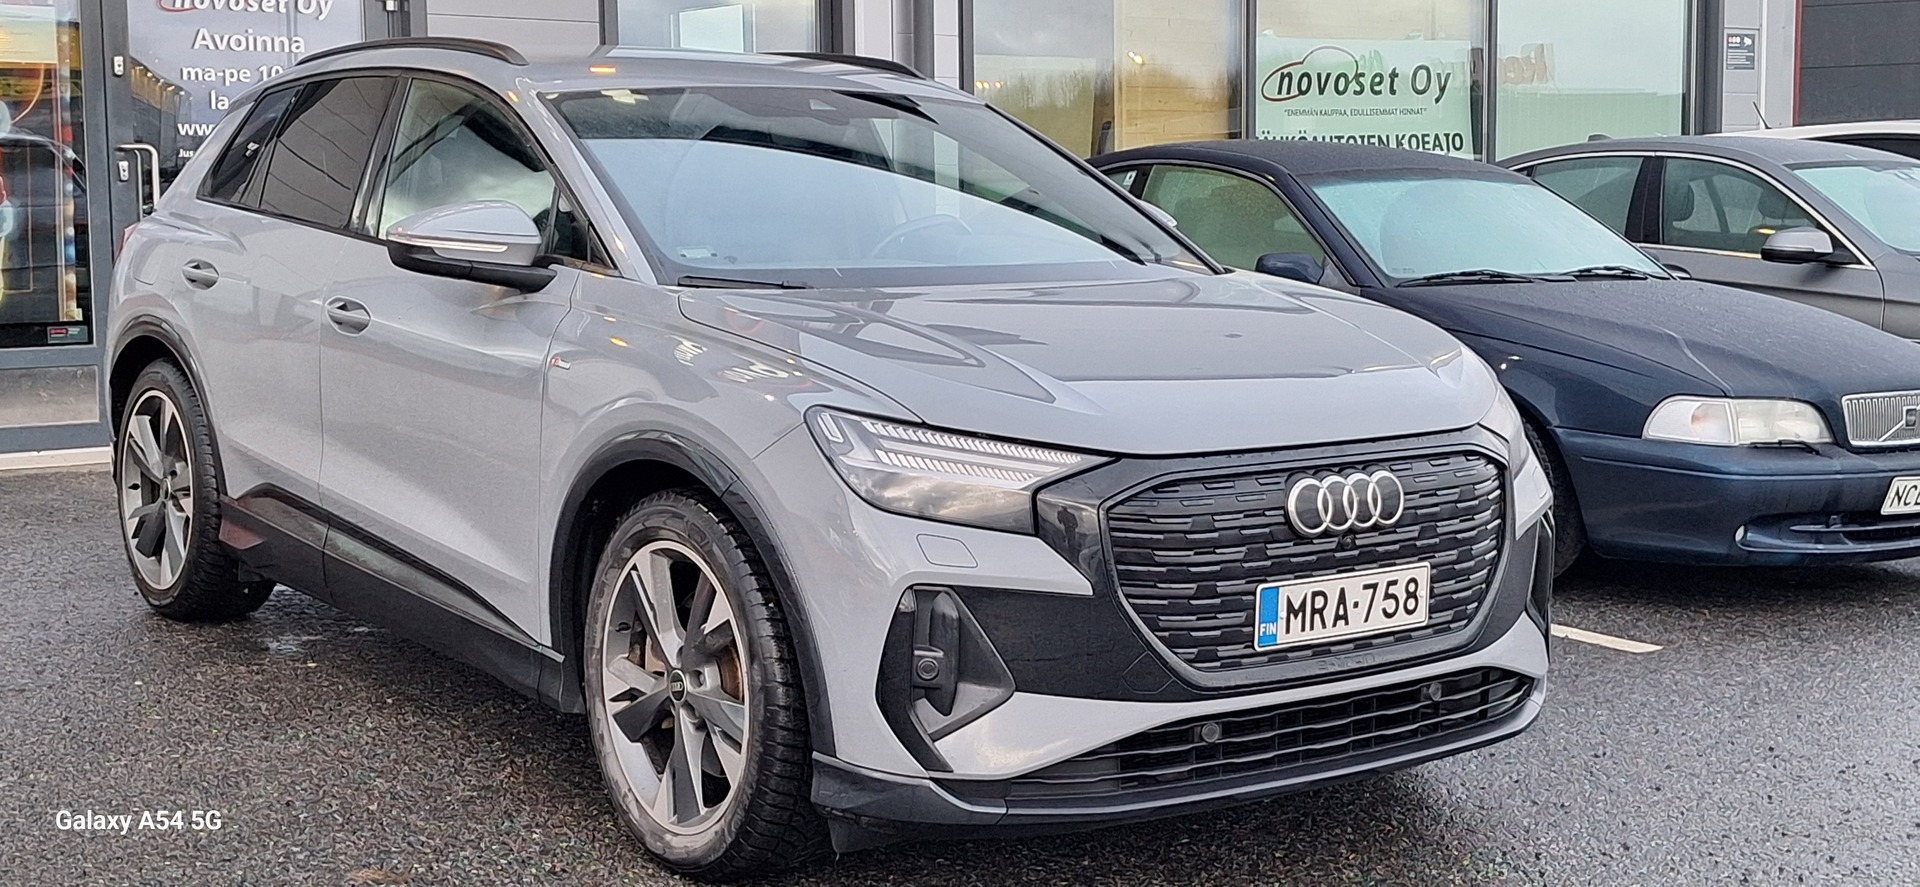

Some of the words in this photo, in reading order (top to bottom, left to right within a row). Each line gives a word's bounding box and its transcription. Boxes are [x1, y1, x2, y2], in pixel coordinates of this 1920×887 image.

[193, 28, 305, 52] Avoinna
[182, 66, 251, 86] ma-pe
[1276, 66, 1399, 96] novoset
[1411, 64, 1451, 104] Oy
[210, 90, 229, 109] la
[177, 123, 215, 136] ww
[1260, 621, 1276, 636] FIN
[1285, 576, 1419, 635] MRA-758
